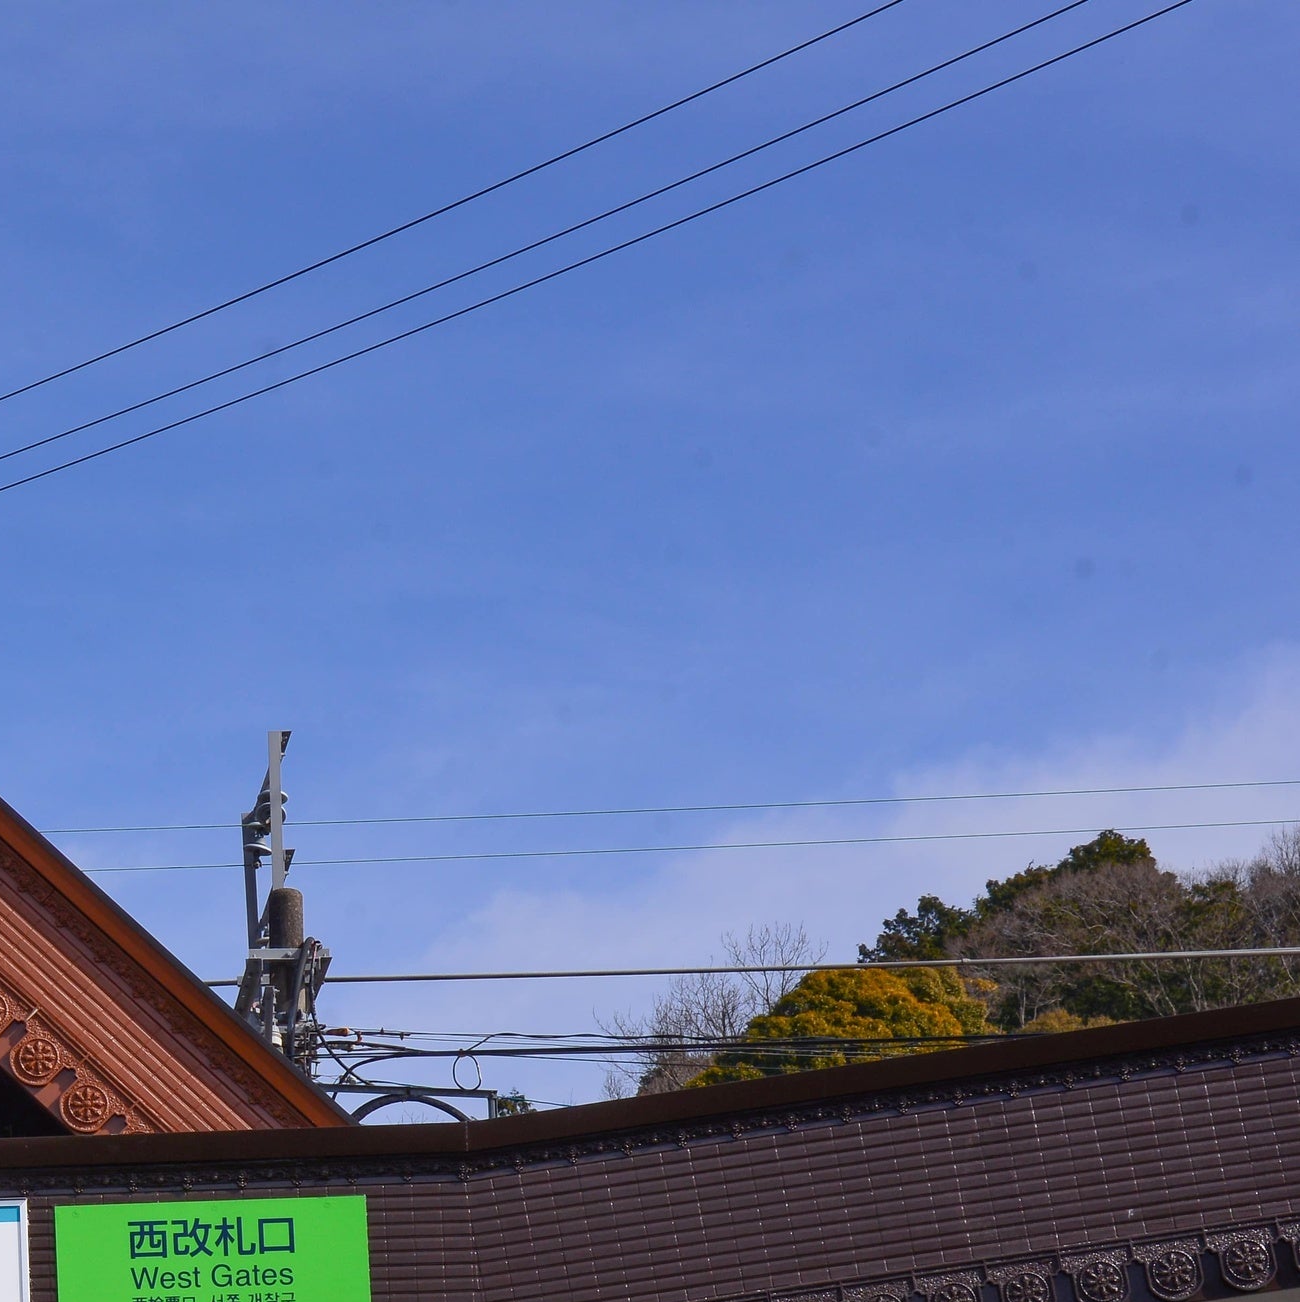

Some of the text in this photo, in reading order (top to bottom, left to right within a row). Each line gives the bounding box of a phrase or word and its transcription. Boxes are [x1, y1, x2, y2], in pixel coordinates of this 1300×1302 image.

[127, 1216, 296, 1260] 西改札口
[130, 1263, 294, 1291] West Gates
